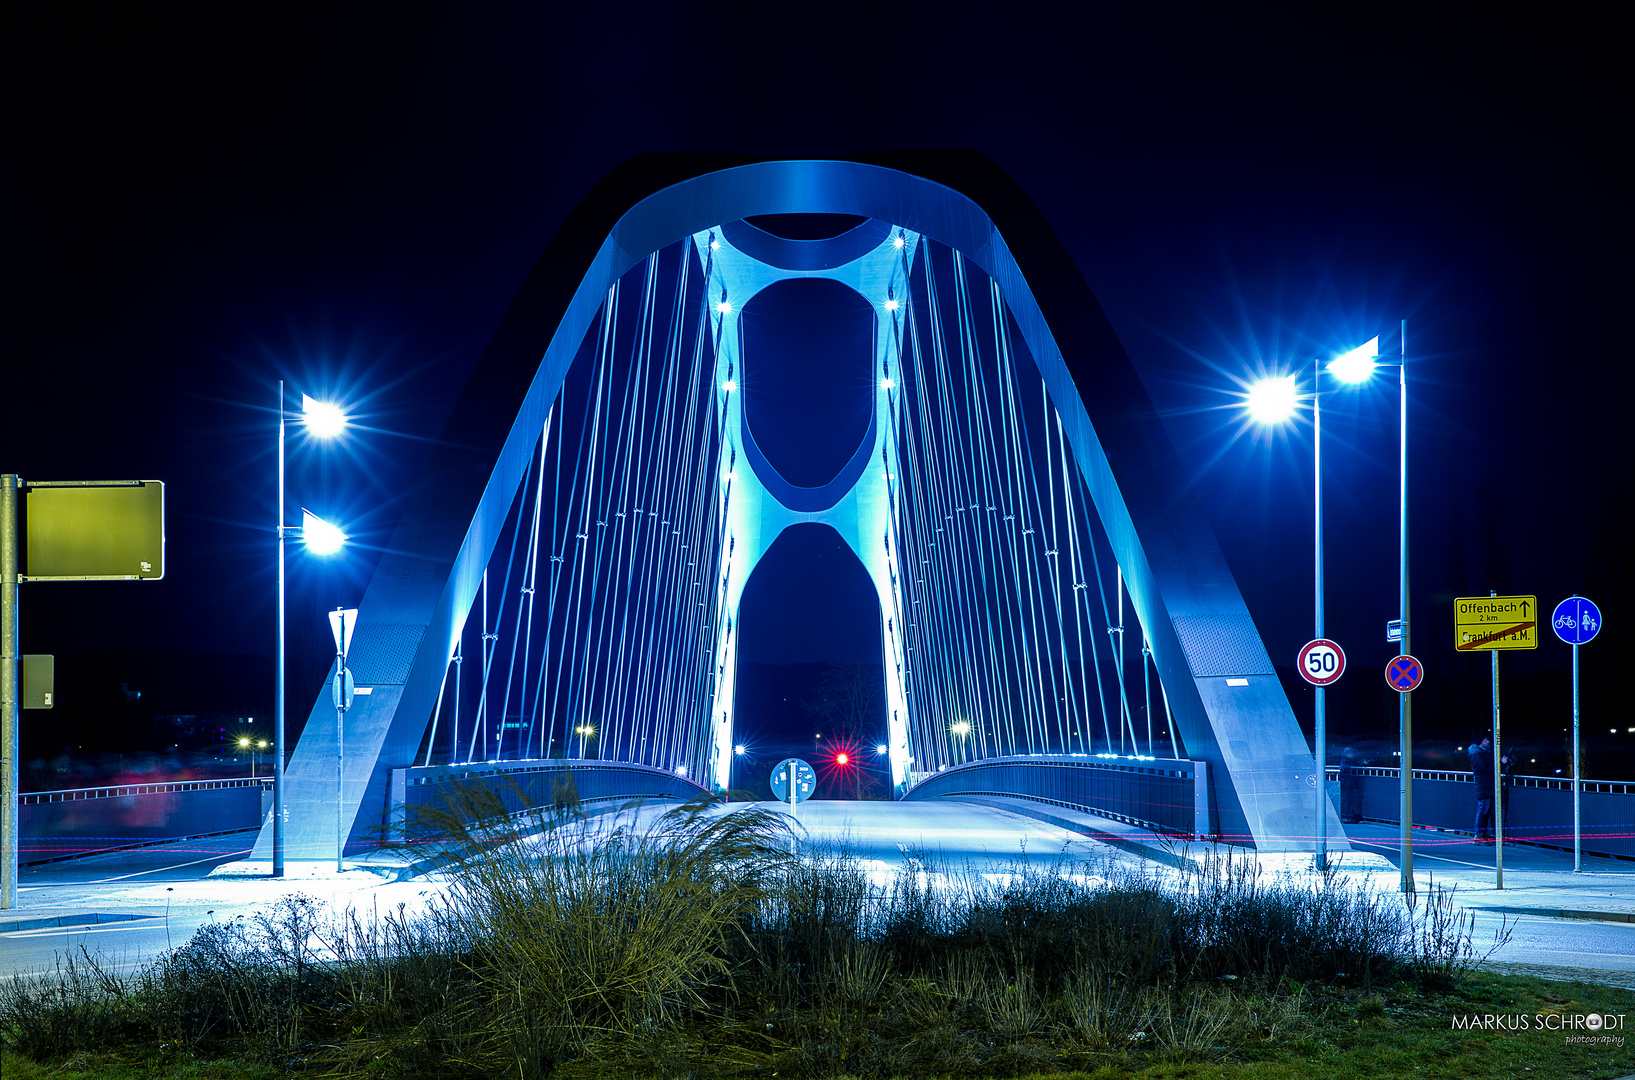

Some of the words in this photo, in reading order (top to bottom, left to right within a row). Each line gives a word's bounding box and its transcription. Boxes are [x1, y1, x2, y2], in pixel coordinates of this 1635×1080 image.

[1460, 602, 1517, 613] Offenbach
[1486, 614, 1498, 622] km
[1462, 631, 1507, 643] Frankfurt
[1511, 629, 1531, 641] a.M.
[1309, 652, 1335, 673] 50
